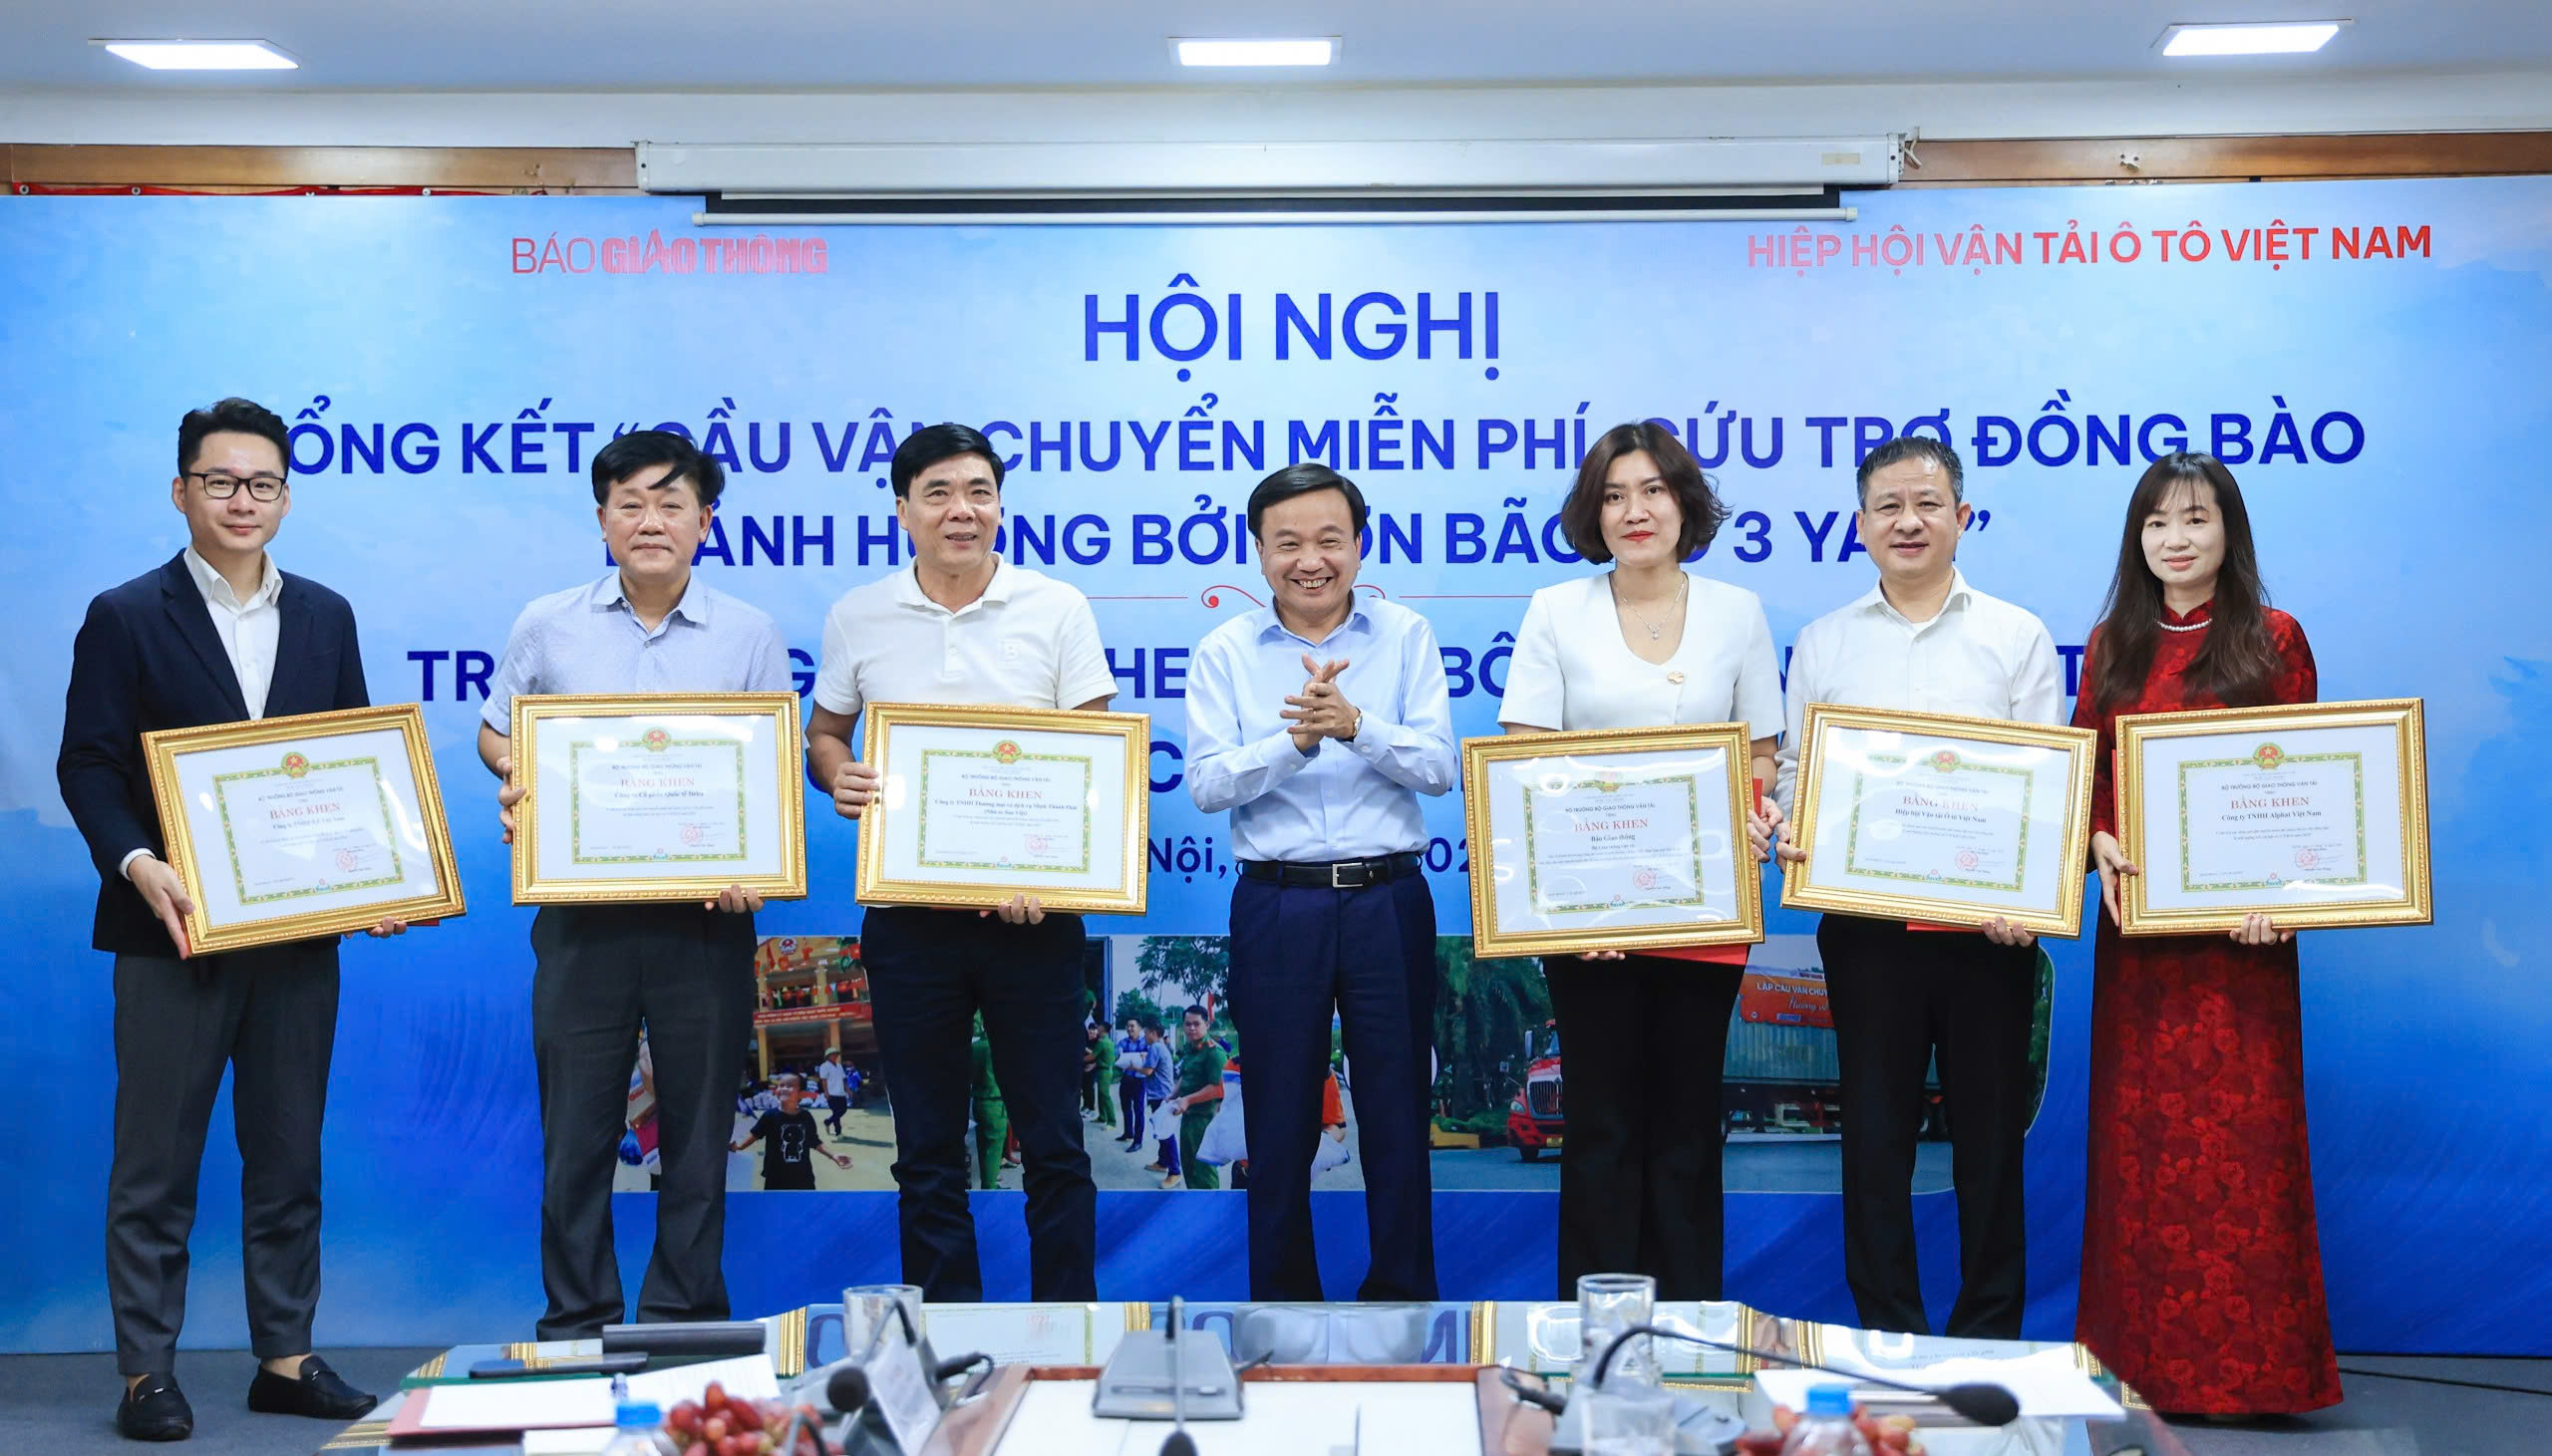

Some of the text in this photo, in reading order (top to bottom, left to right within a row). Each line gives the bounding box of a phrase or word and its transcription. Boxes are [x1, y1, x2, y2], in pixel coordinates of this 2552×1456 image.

[511, 231, 595, 274] BÁO
[699, 234, 828, 274] THÔNG
[1748, 218, 2432, 278] HIỆP HỘI VẬN TẢI Ô TÔ VIỆT NAM
[1085, 273, 1499, 383] HỘI NGHỊ
[287, 395, 440, 474] ỔNG
[462, 398, 595, 473] KẾT
[981, 393, 1275, 472] CHUYỂN
[1290, 393, 1453, 470] MIỄN
[1478, 402, 1590, 469] PHÍ
[1972, 388, 2189, 467] ĐỒNG
[2212, 396, 2365, 465] BÀO
[1132, 494, 1247, 566] BỞI
[1445, 497, 1585, 564] BÃO
[1734, 510, 1772, 563] 3
[1613, 818, 1649, 830] KHEN
[2271, 796, 2310, 808] KHEN
